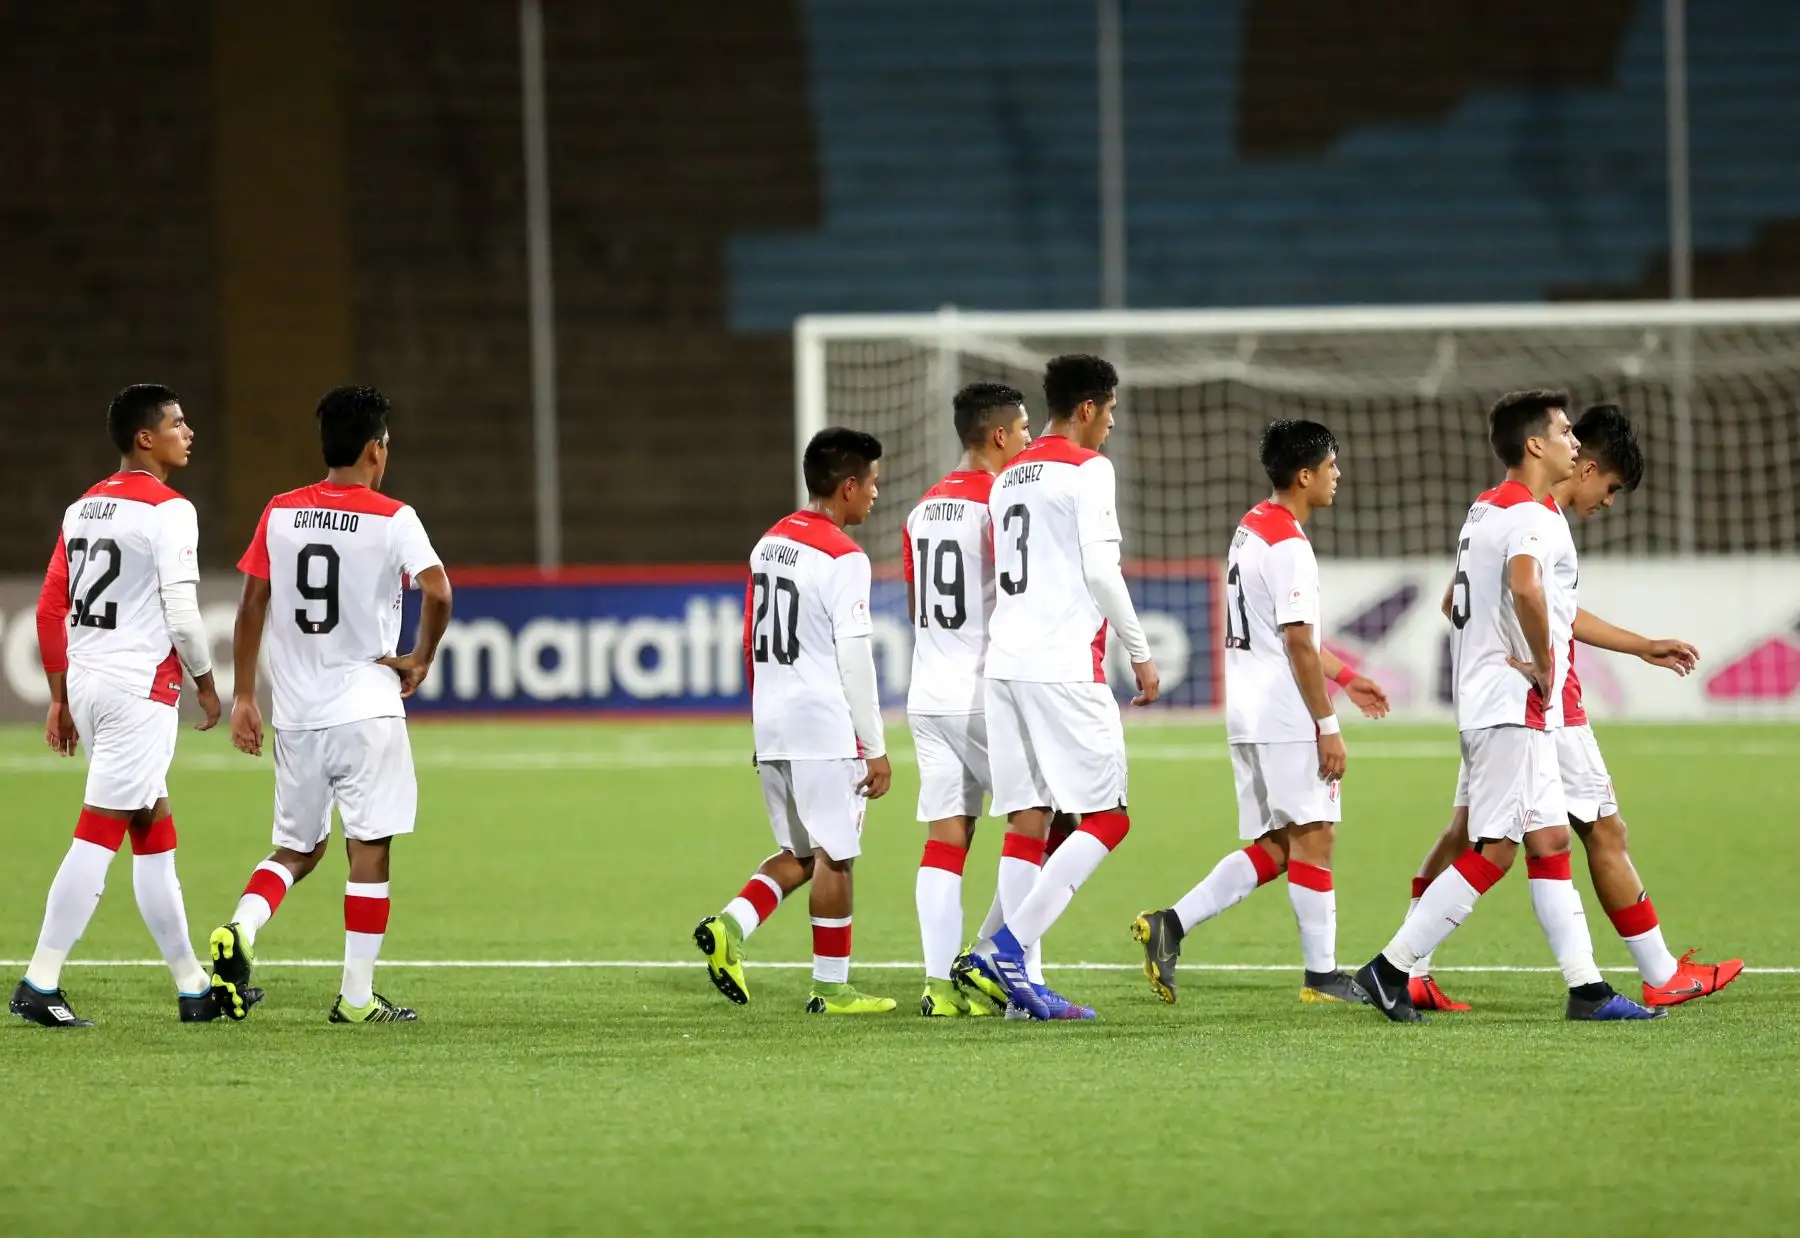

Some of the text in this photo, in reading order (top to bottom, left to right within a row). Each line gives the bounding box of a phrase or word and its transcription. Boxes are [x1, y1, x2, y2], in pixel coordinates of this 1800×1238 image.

[1002, 464, 1044, 489] SANCHEZ
[78, 502, 117, 521] AGUILAR
[293, 510, 359, 533] GRIMALDO
[922, 503, 965, 521] MONTOYA
[760, 543, 799, 568] HUAYHUA
[999, 503, 1031, 596] 3
[67, 537, 122, 631] 22
[295, 543, 340, 634] 9
[917, 538, 967, 630] 19
[752, 573, 800, 666] 20
